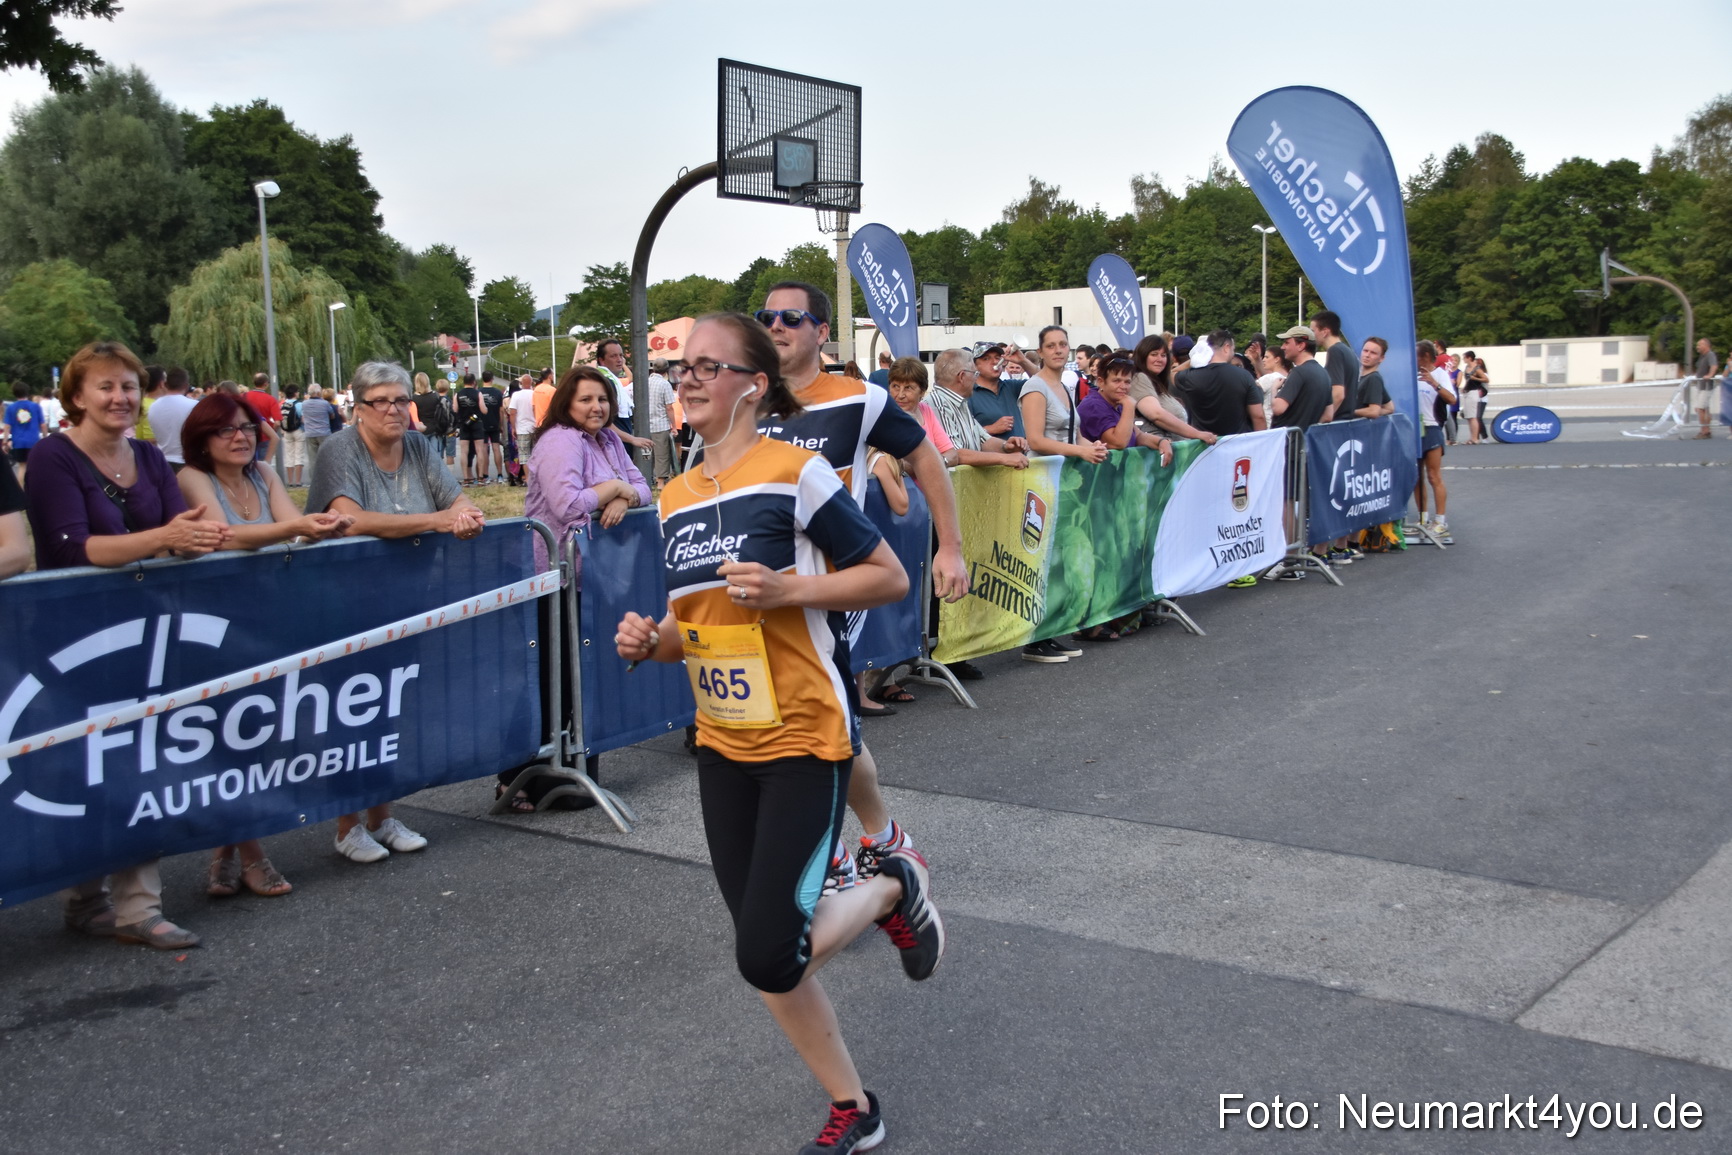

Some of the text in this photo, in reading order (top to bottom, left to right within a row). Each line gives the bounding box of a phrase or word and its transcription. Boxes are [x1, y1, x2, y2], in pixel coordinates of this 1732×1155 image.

[1511, 421, 1553, 431] Fischer
[1346, 495, 1391, 517] AUTOMOBILE
[674, 534, 748, 562] Fischer
[698, 665, 751, 700] 465
[87, 664, 420, 787] Fischer
[127, 733, 400, 827] AUTOMOBILE
